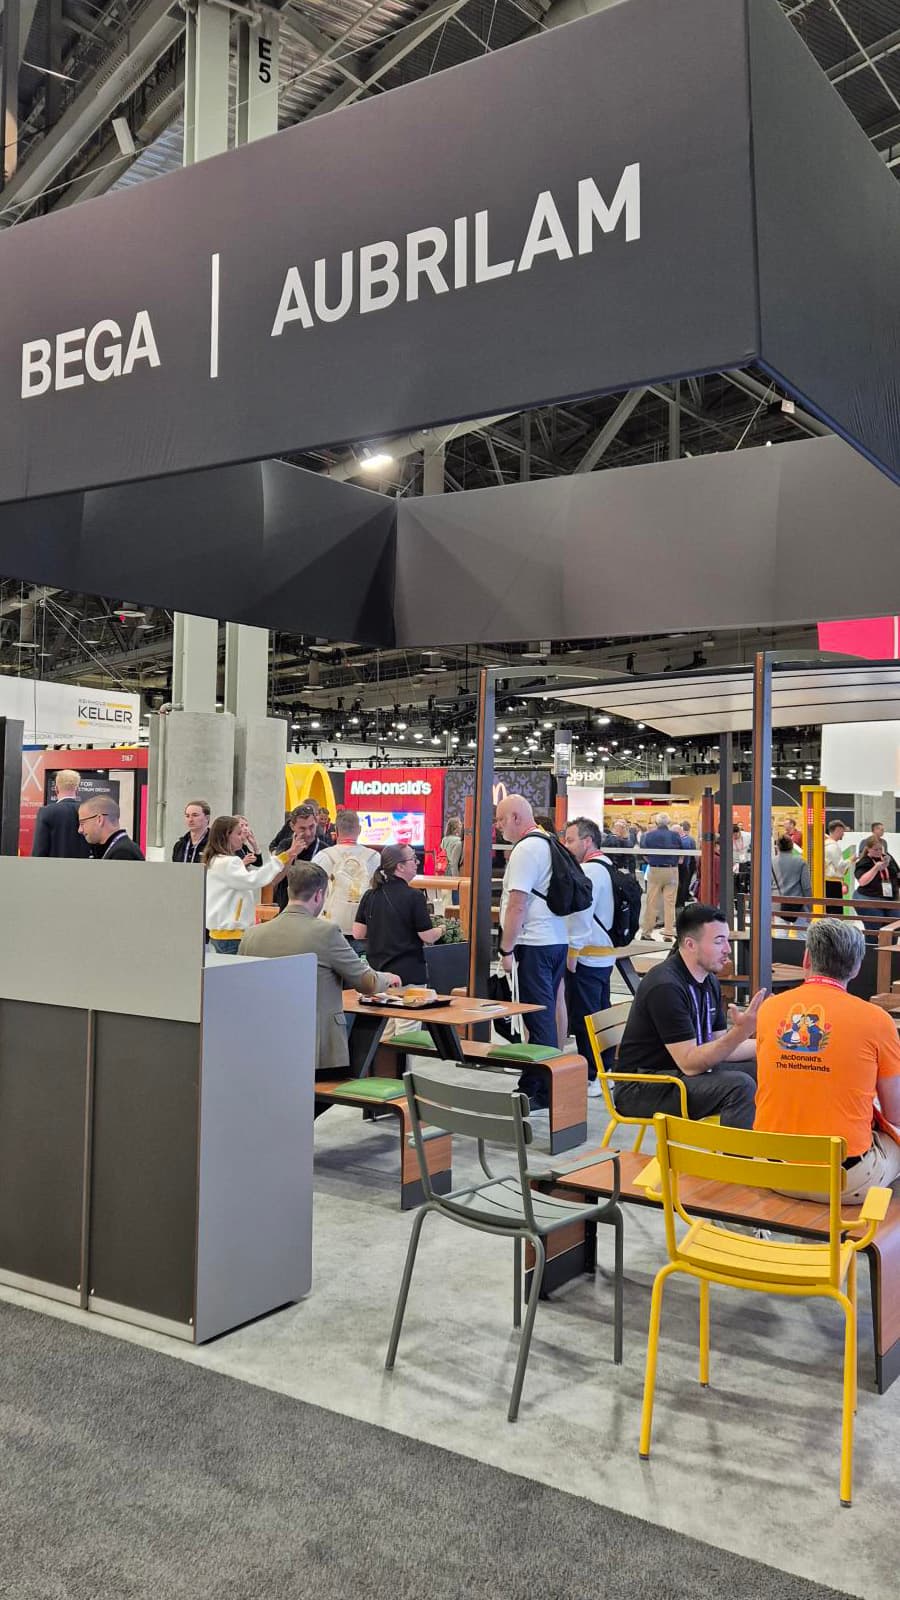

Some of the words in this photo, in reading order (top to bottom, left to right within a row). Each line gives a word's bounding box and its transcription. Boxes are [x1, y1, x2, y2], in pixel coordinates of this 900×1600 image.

[21, 310, 161, 398] BEGA
[271, 163, 640, 336] AUBRILAM
[78, 705, 133, 723] KELLER
[351, 780, 432, 795] McDonald's
[781, 1054, 823, 1063] McDonald's
[788, 1063, 831, 1073] Netherlands
